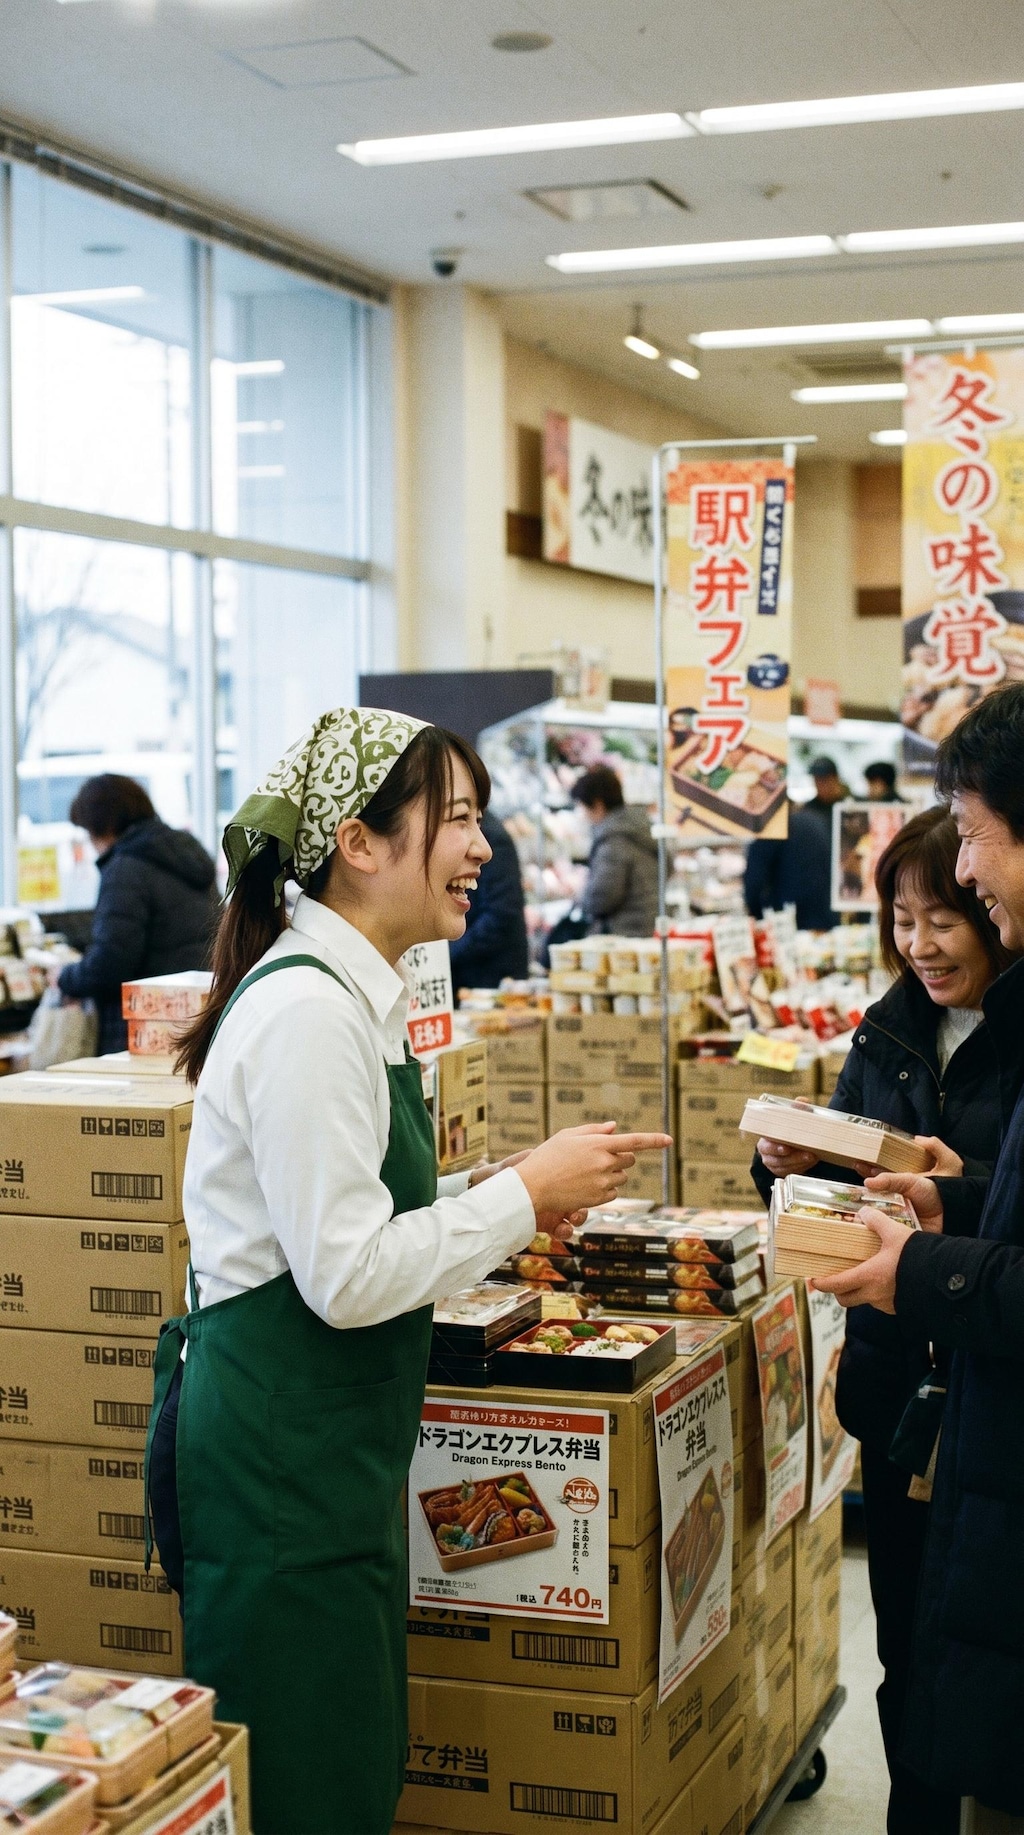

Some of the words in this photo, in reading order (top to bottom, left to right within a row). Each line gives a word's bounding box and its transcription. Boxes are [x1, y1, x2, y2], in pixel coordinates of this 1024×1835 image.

[931, 373, 1005, 676] 冬の味覚
[693, 488, 752, 768] 駅弁フェア
[419, 1425, 600, 1461] ドラゴンエクプレス弁当
[685, 1421, 707, 1460] 弁当
[452, 1453, 489, 1466] Dragon
[492, 1457, 533, 1469] Express
[536, 1460, 566, 1472] Bento
